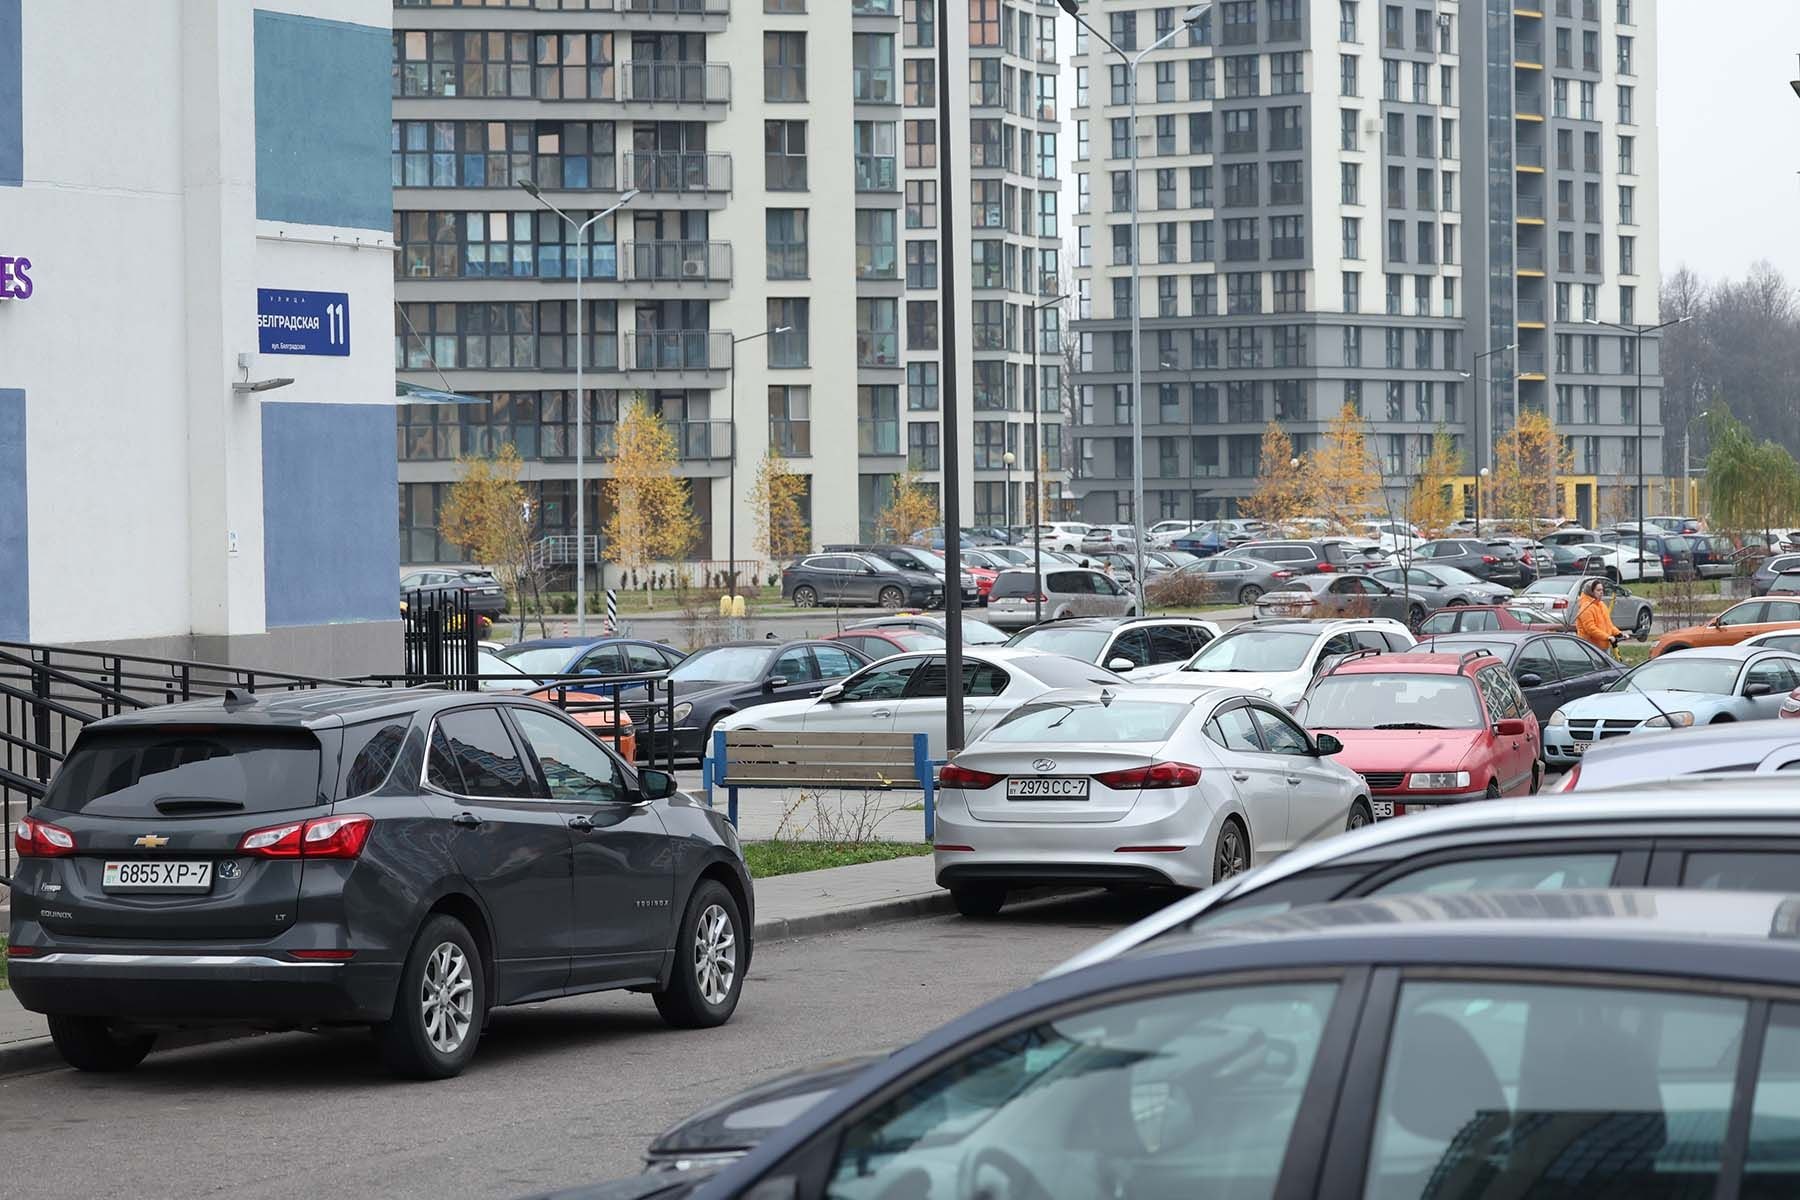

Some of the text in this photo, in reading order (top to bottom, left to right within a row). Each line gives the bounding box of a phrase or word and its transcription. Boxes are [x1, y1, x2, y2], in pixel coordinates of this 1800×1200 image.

[0, 256, 33, 299] ES
[257, 315, 320, 331] БЕЛГРАДСКАЯ
[326, 303, 344, 345] 11
[1020, 780, 1086, 794] 2979 CC-7
[120, 864, 209, 884] 6855 XP-7
[40, 909, 73, 919] EQUINOX
